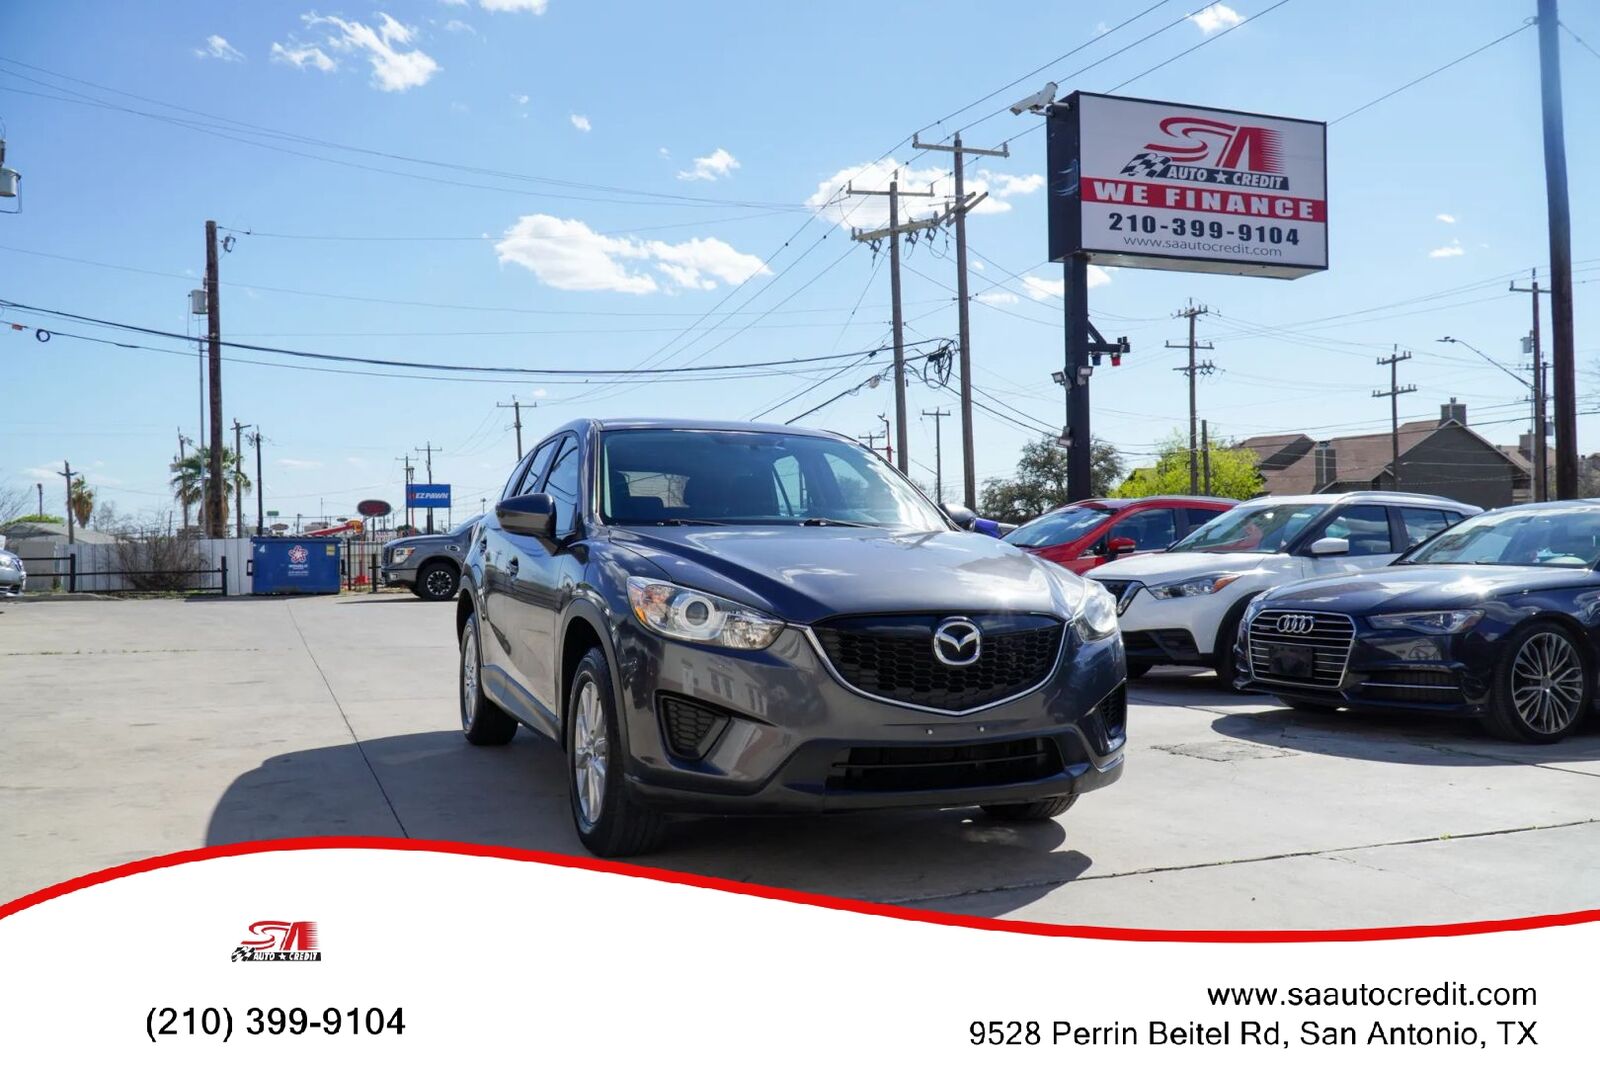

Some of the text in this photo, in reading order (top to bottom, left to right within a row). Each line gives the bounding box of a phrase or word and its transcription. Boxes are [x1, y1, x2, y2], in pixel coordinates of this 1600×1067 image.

[1166, 165, 1284, 190] AUTO CREDIT
[1092, 181, 1314, 219] WE FINANCE
[1108, 212, 1300, 246] 210-399-9104
[1123, 236, 1282, 257] www.saautocredit.com
